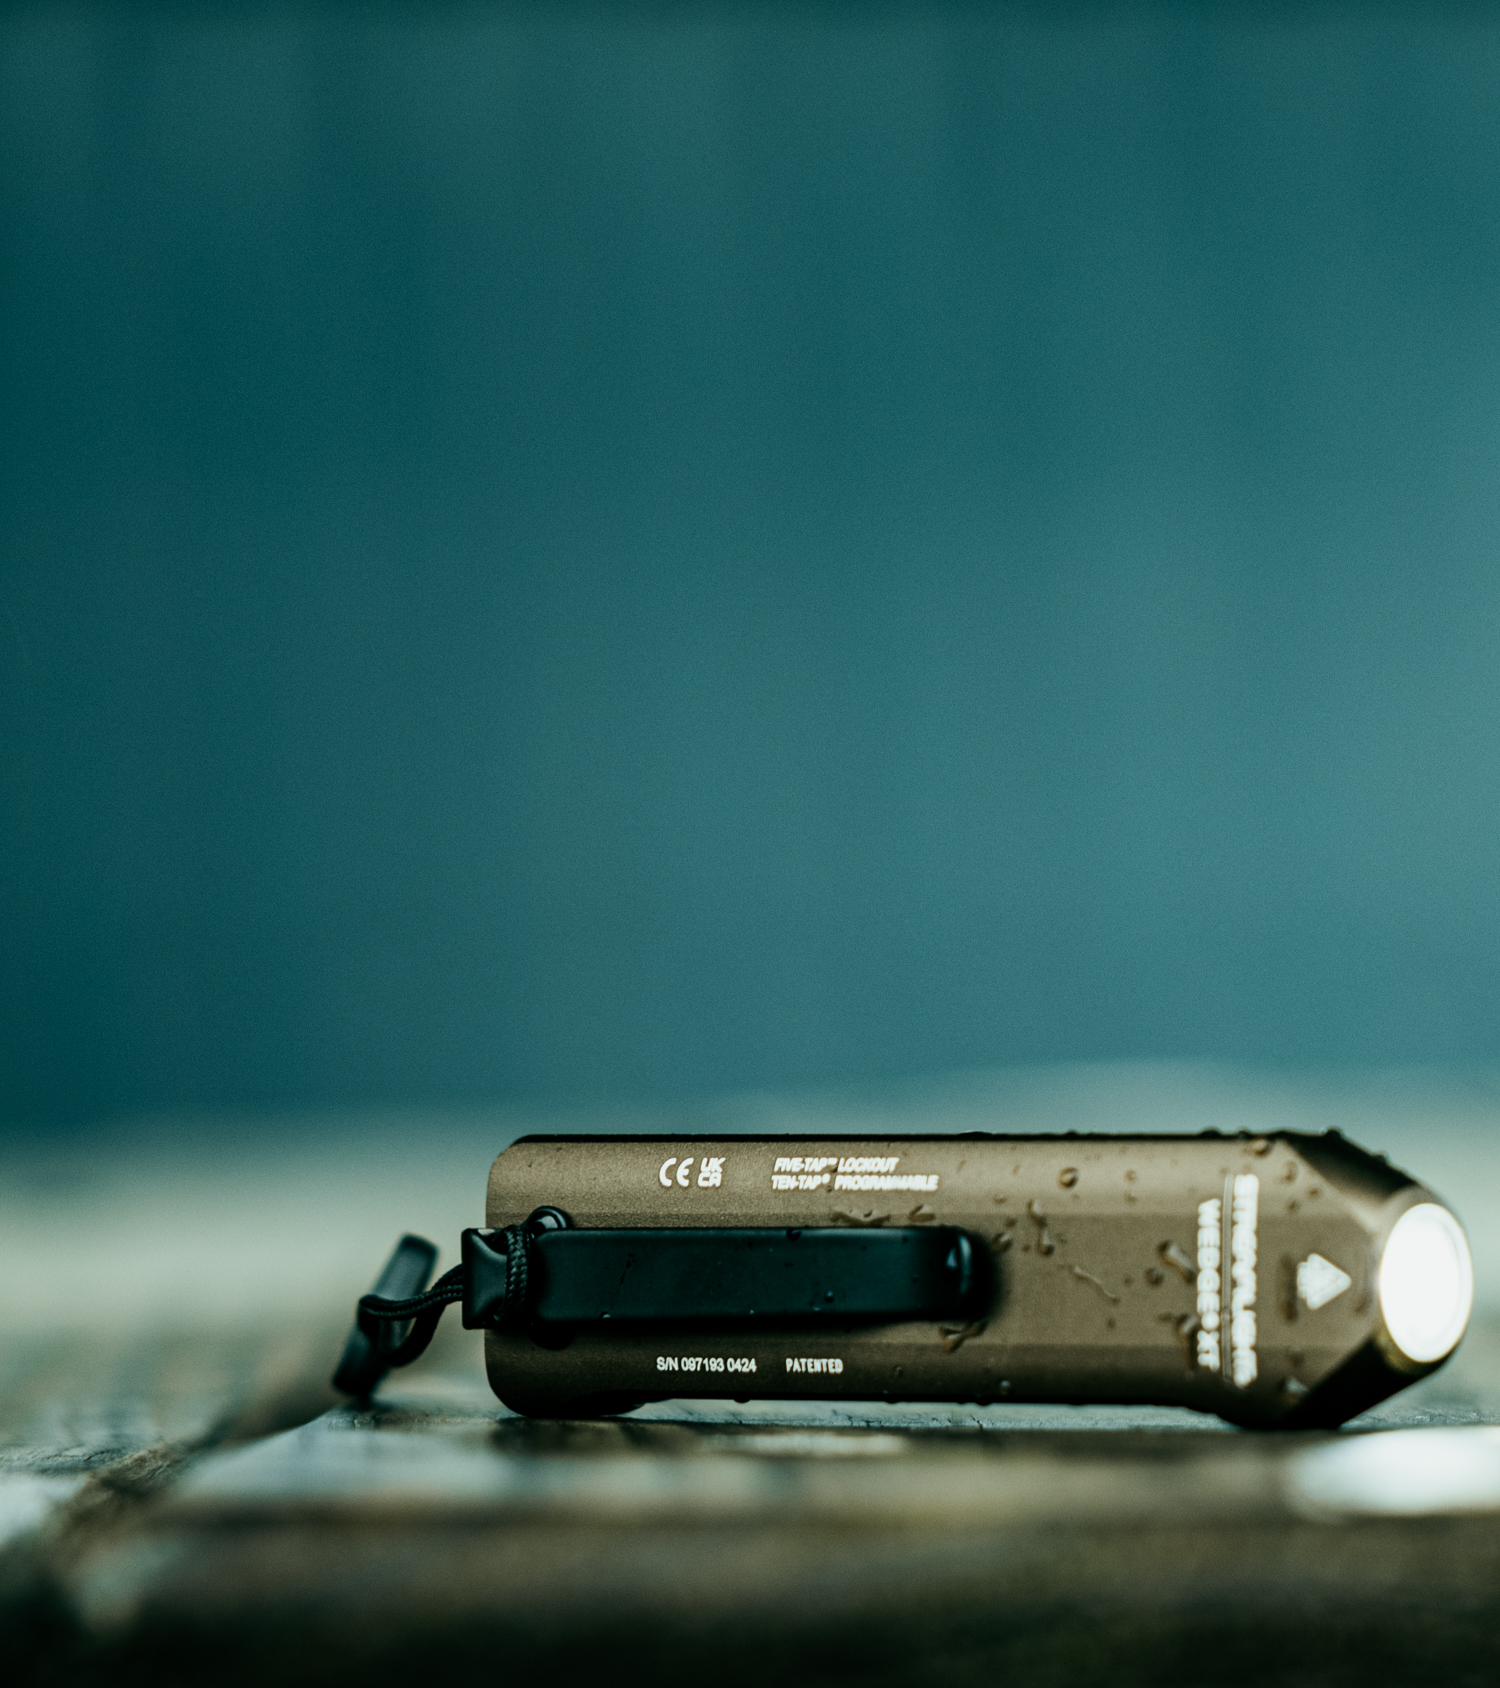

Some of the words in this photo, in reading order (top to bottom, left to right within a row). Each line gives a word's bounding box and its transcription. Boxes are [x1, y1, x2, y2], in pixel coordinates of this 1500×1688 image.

[660, 1158, 694, 1186] CE
[701, 1158, 725, 1172] UK
[838, 1157, 899, 1172] LOCKOUT
[698, 1172, 721, 1186] CA
[835, 1175, 939, 1190] PROGRAMMABLE
[657, 1357, 678, 1370] S/N
[681, 1357, 724, 1371] 097193
[727, 1358, 756, 1372] 0424
[786, 1358, 843, 1373] PATENTED
